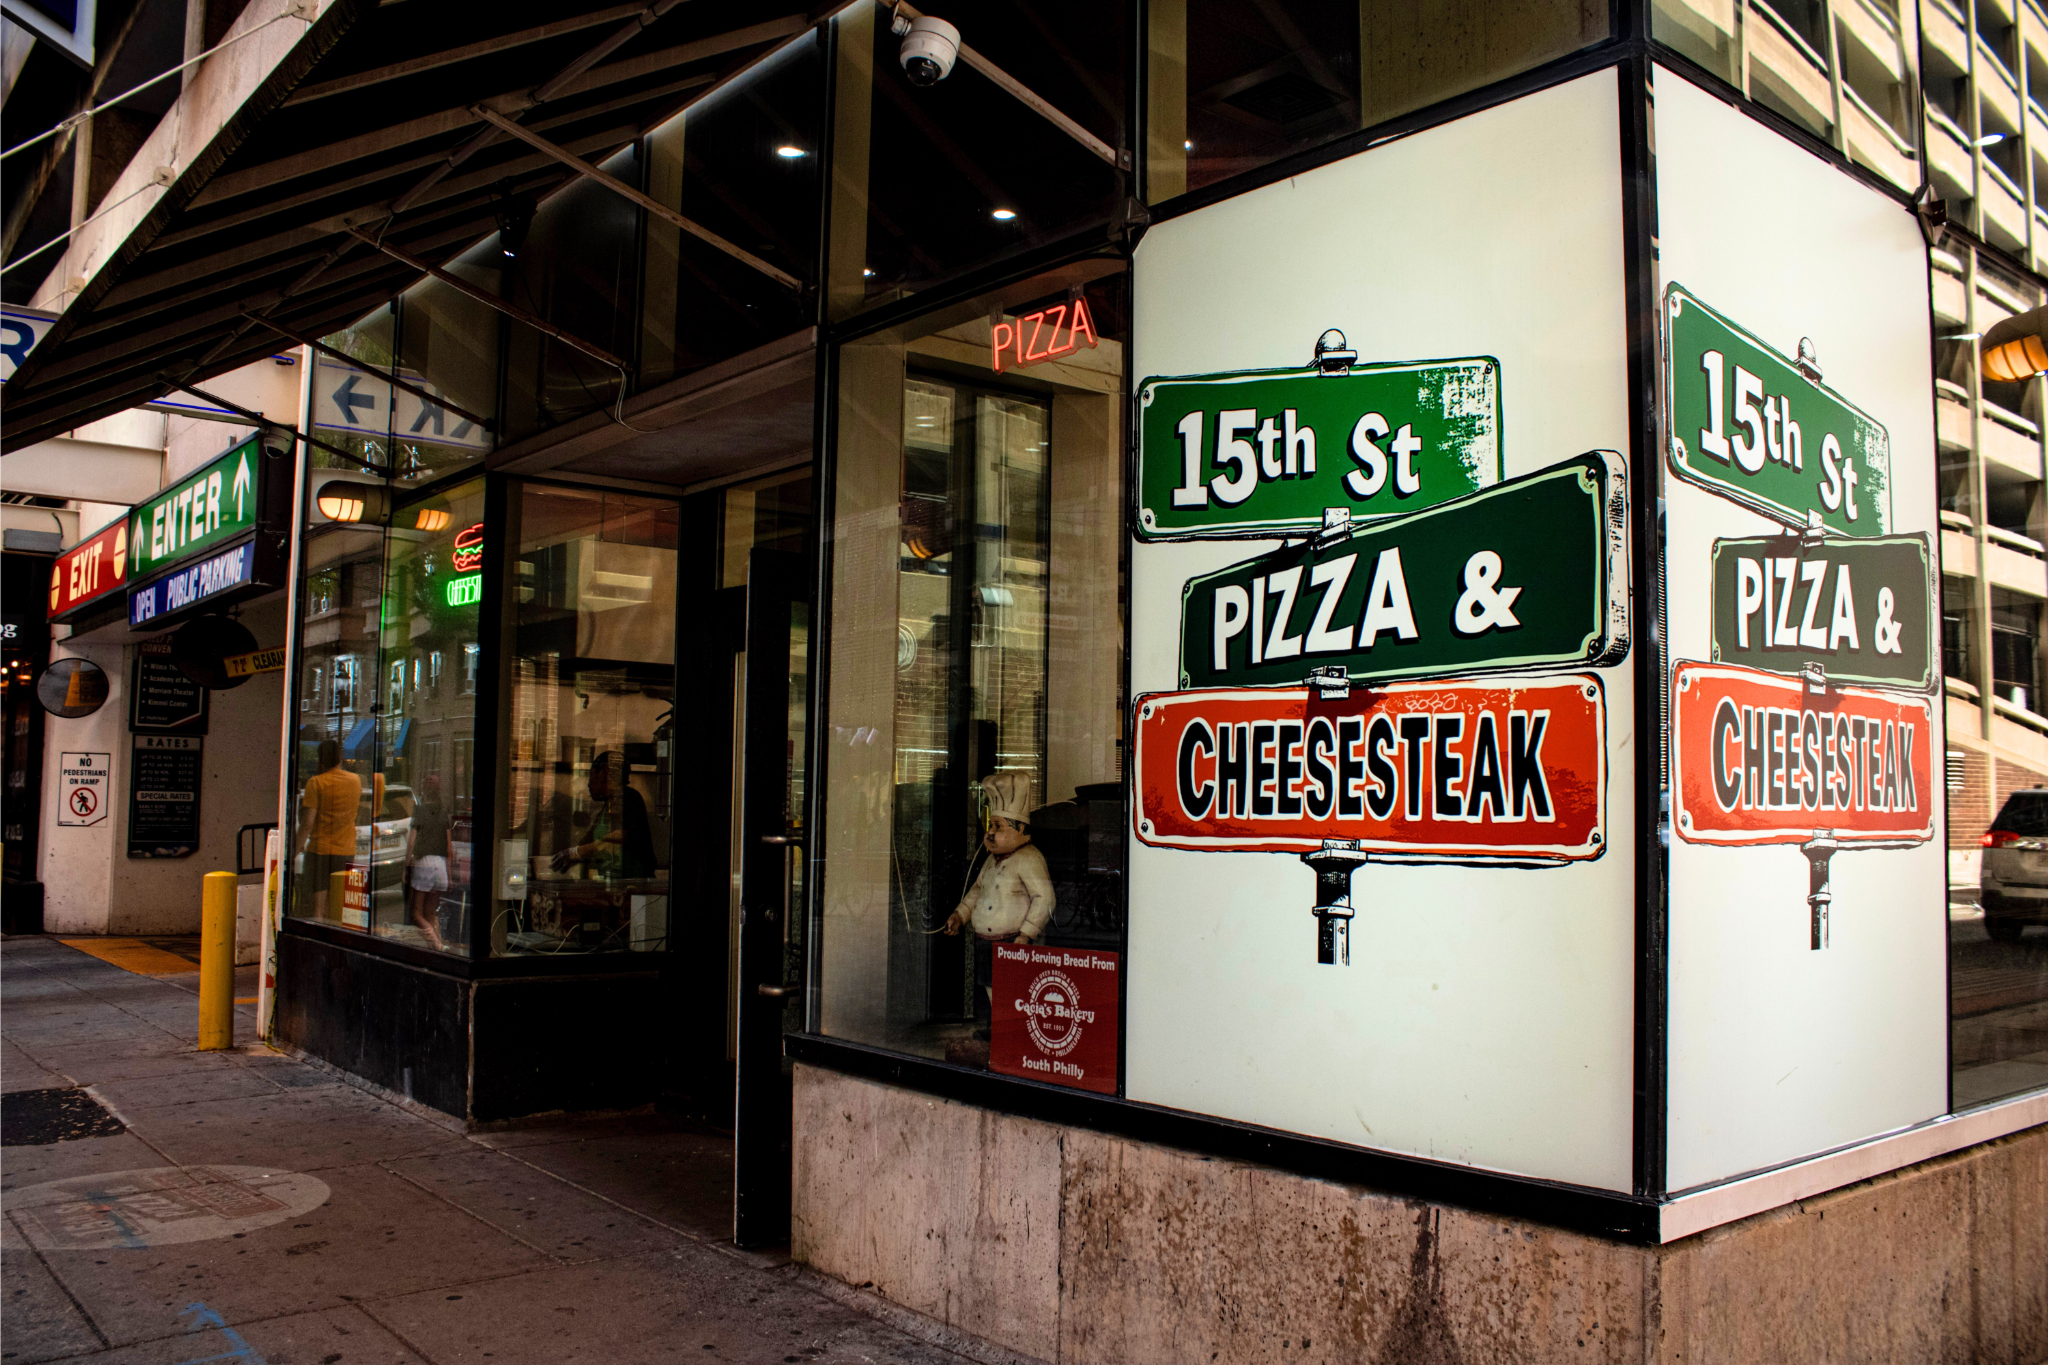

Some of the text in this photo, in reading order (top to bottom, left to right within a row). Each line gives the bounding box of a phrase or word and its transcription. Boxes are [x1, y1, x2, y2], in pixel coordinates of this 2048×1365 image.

[993, 298, 1095, 370] PIZZA
[1701, 349, 1858, 521] 15th St
[1172, 407, 1423, 507] 15th St
[151, 470, 222, 561] ENTER
[69, 540, 103, 602] EXIT
[136, 546, 245, 623] OPEN PUBLIC PARKING
[1213, 546, 1522, 671] PIZZA &
[1736, 557, 1903, 655] PIZZA &
[149, 675, 173, 684] Academy
[173, 688, 194, 696] Theater
[147, 738, 189, 748] RATES
[1711, 695, 1918, 812] CHEESESTEAK
[80, 758, 92, 767] NO
[1176, 709, 1556, 823] CHEESESTEAK
[170, 793, 191, 801] RATES
[348, 868, 368, 887] HELP
[997, 946, 1115, 971] Proudly Serving Bread From
[1051, 969, 1067, 979] BREAD
[1014, 998, 1095, 1023] Cacia's Bakery
[1055, 1027, 1083, 1058] PHILADELPHIA
[1022, 1055, 1084, 1080] South Philly
